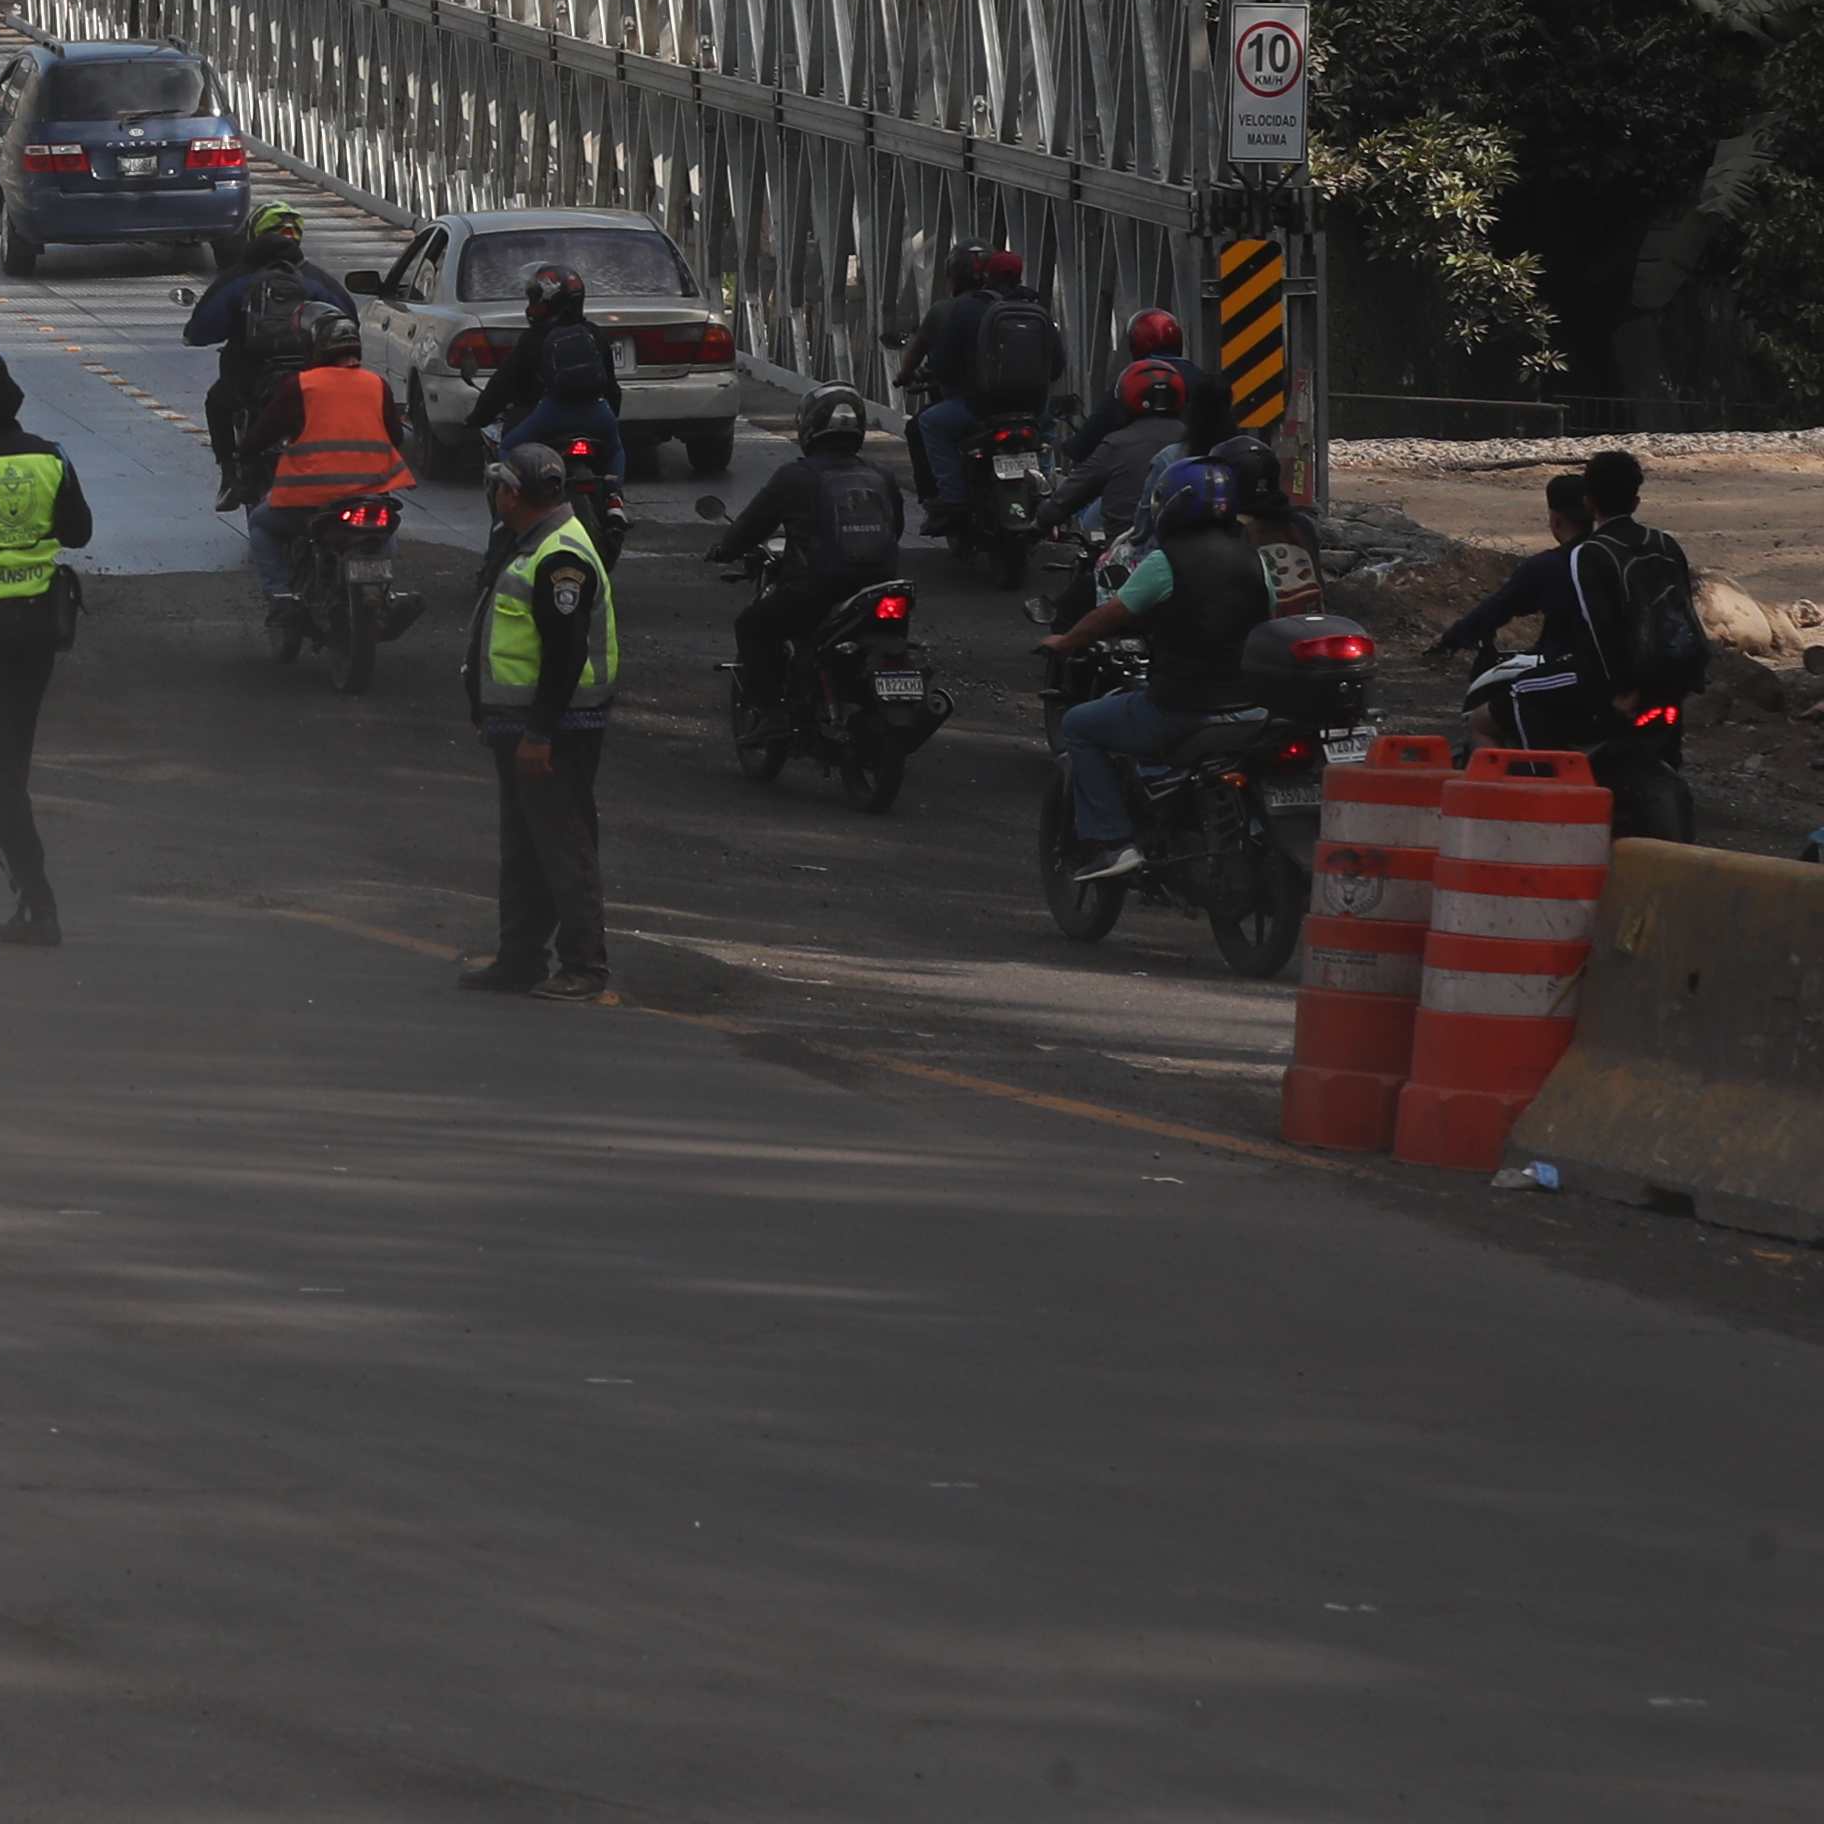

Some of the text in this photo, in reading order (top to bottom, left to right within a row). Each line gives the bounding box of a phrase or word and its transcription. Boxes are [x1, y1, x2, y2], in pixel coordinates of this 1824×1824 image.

[1247, 33, 1291, 74] 10
[1254, 76, 1284, 86] KM/H
[1238, 113, 1297, 127] VELOCIDAD
[1247, 133, 1287, 146] MAXIMA
